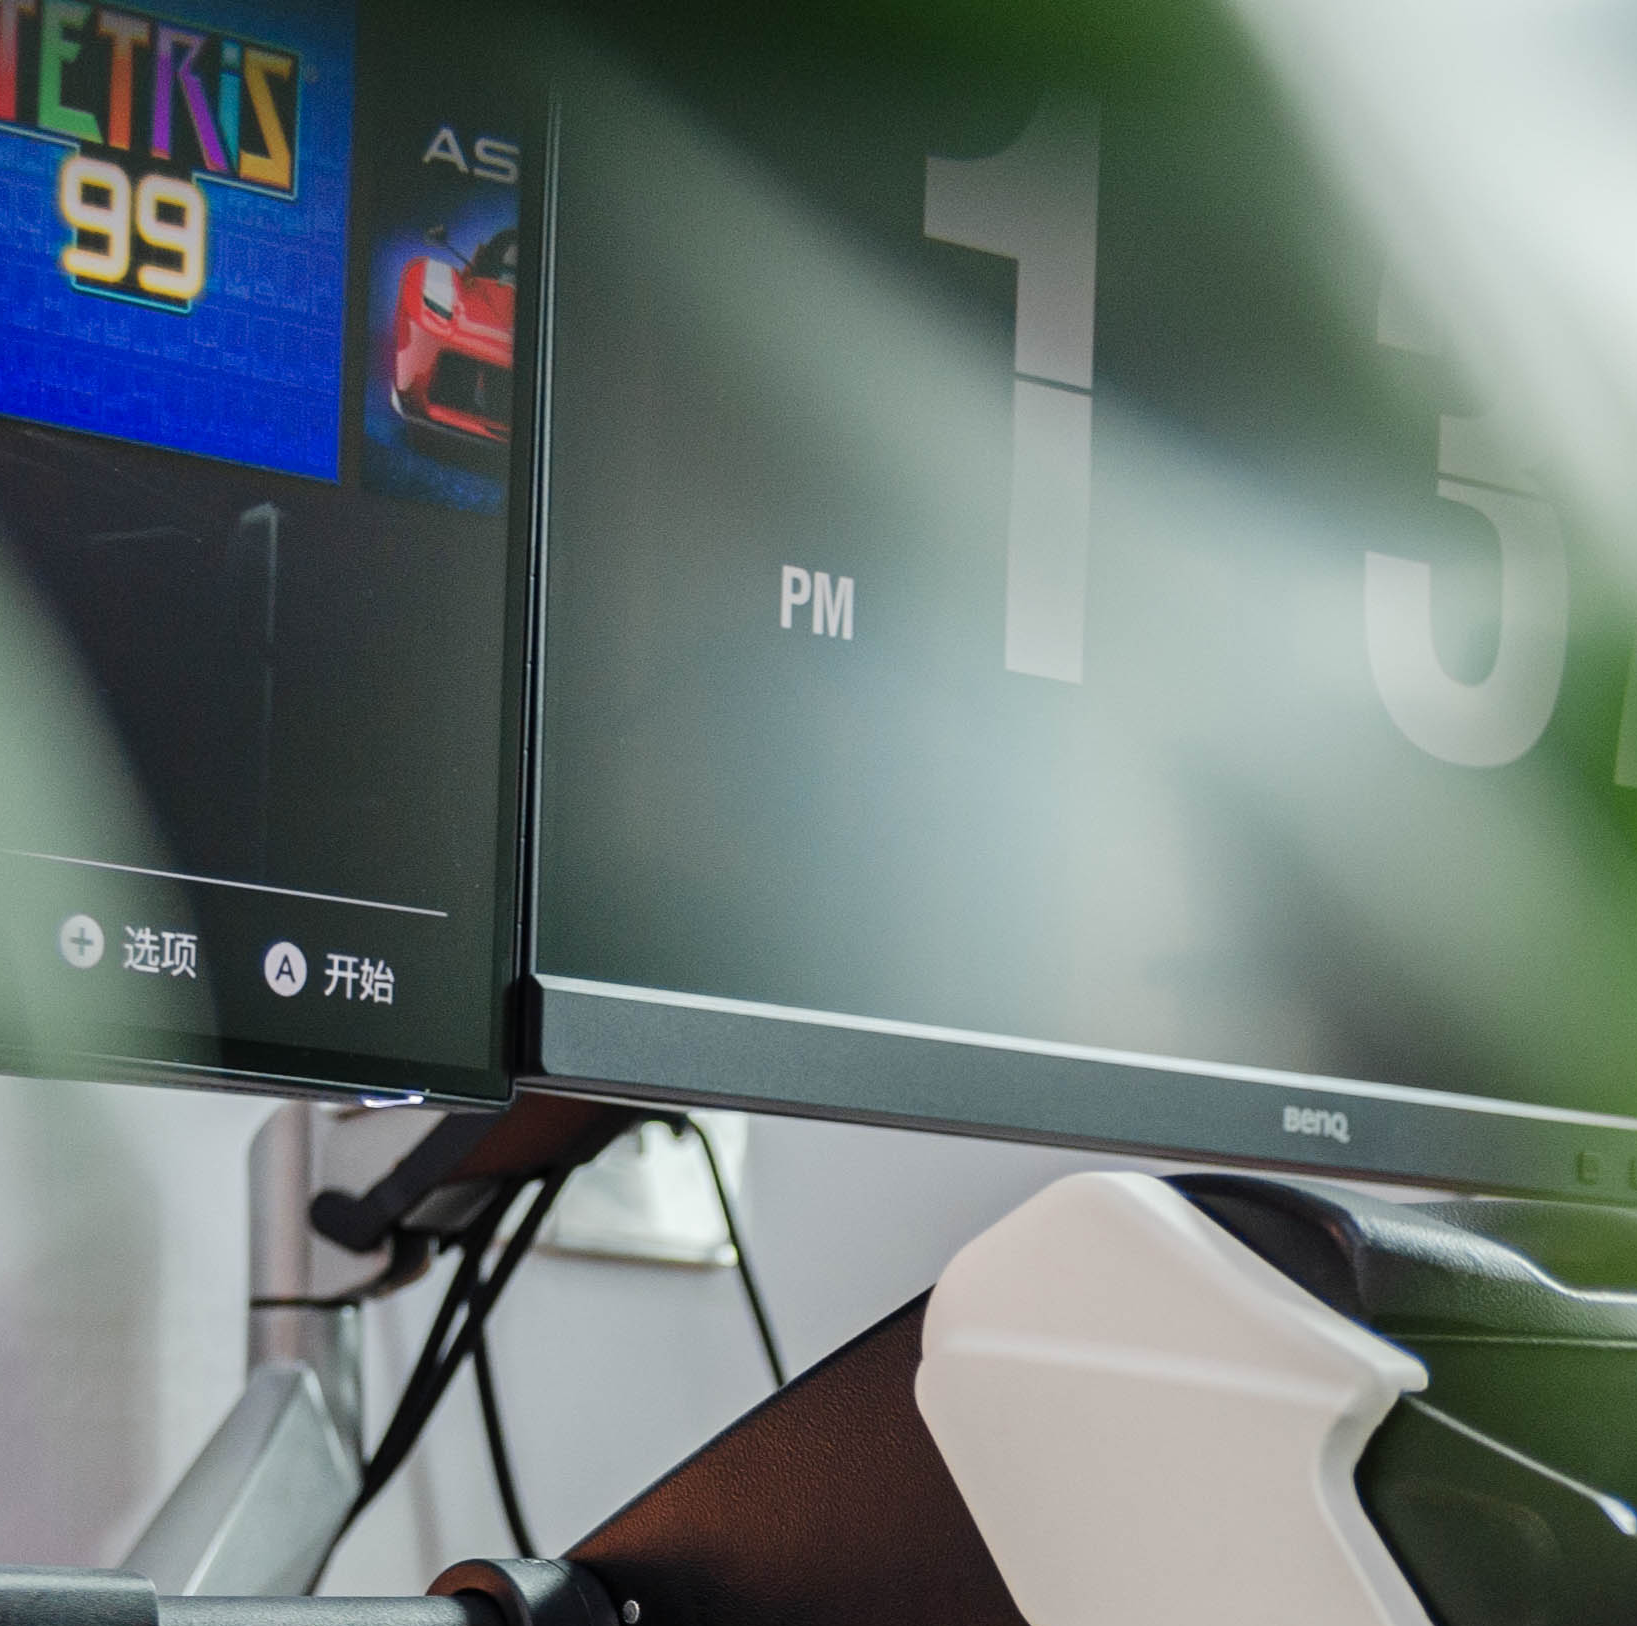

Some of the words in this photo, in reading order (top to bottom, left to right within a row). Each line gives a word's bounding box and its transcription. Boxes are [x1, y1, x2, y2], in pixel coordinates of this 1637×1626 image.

[62, 154, 207, 303] 99
[778, 562, 855, 643] PM
[123, 926, 198, 979] 选项
[324, 952, 395, 1005] 开始
